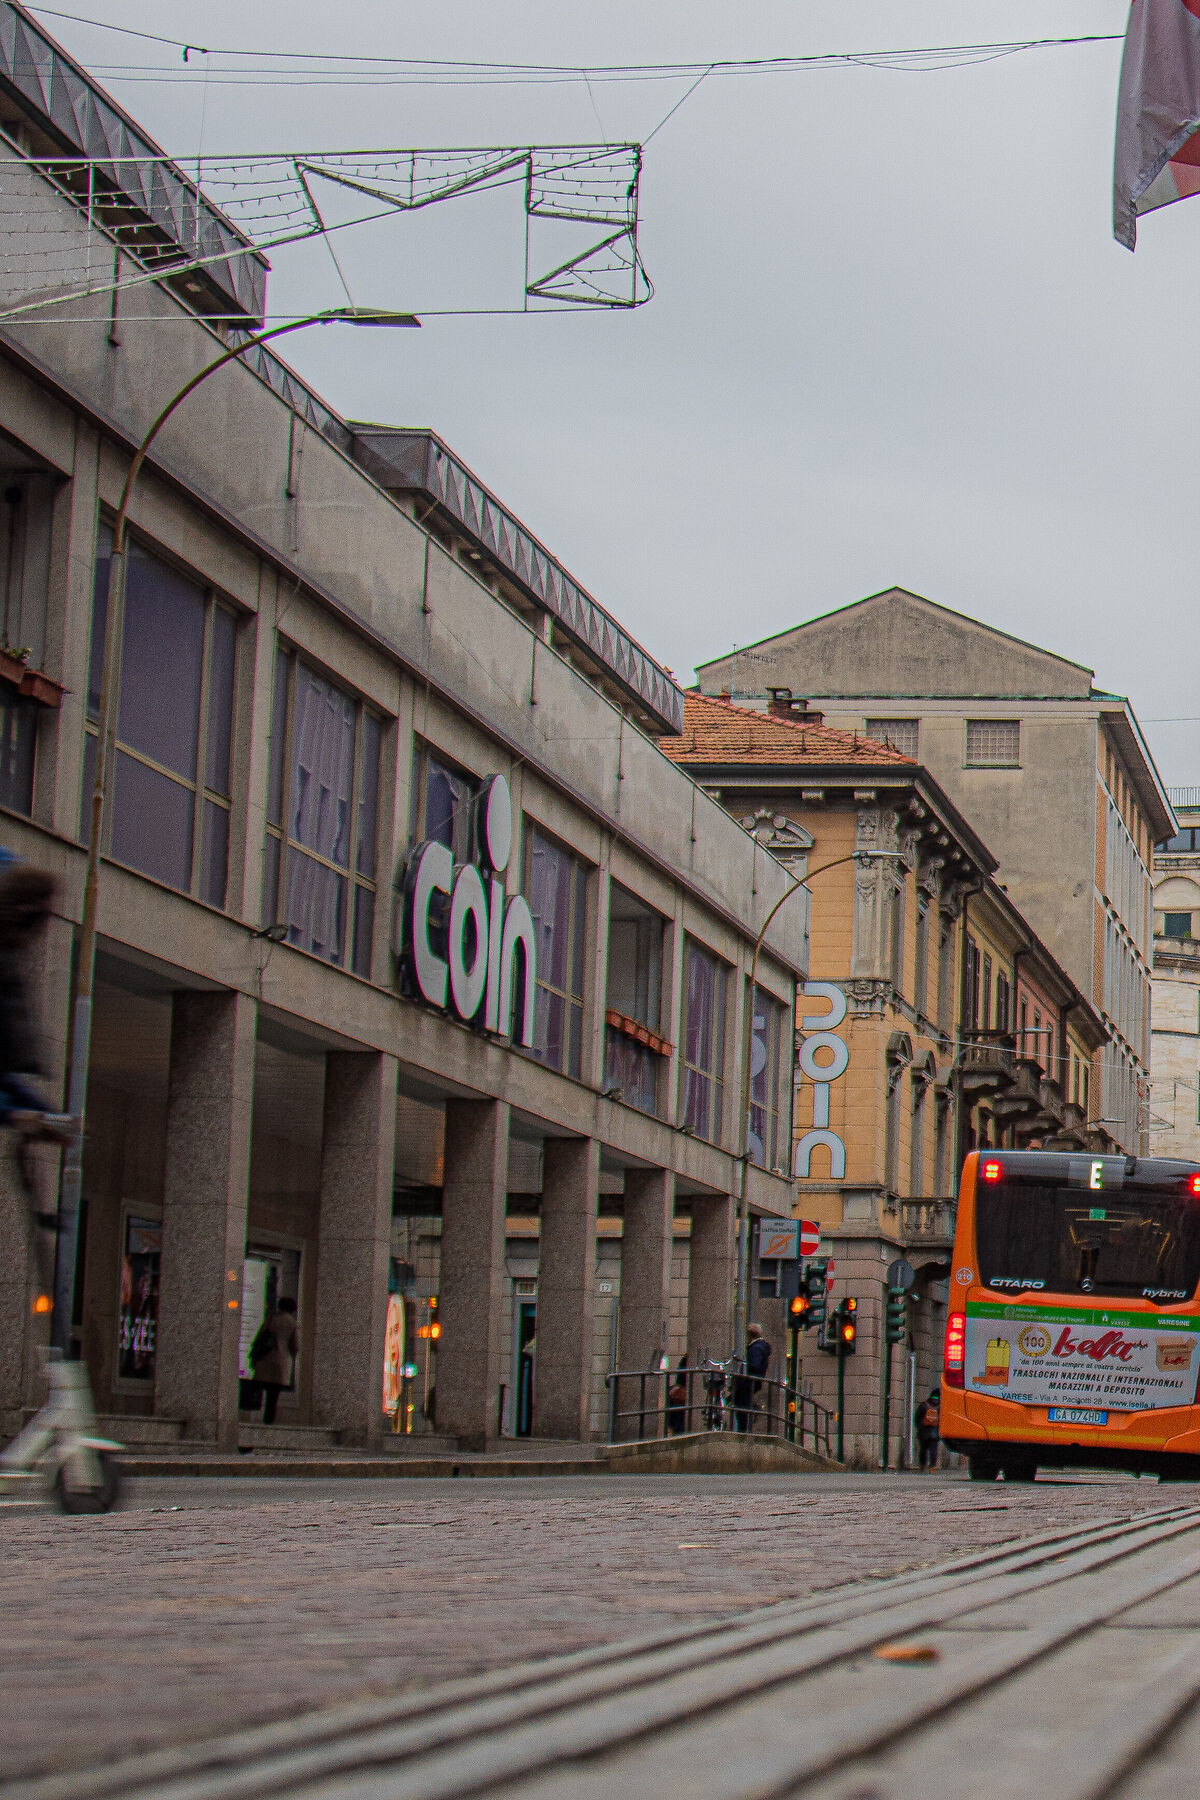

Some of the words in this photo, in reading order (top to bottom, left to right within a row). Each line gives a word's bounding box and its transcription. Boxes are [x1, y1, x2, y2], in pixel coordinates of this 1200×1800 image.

[411, 773, 537, 1049] coin
[1090, 1160, 1104, 1189] E
[989, 1278, 1045, 1289] CITARO
[1142, 1287, 1187, 1298] hybrid
[1024, 1336, 1045, 1348] 100
[1051, 1326, 1134, 1362] Isella
[1012, 1369, 1059, 1379] TRASLOCHI
[1060, 1372, 1104, 1382] NAZIONALI
[1113, 1376, 1184, 1389] INTERNAZIONALI
[1048, 1381, 1093, 1392] MAGAZZINI
[1095, 1385, 1101, 1393] A
[1103, 1386, 1146, 1396] DEPOSITO
[1000, 1392, 1033, 1401] VARESE
